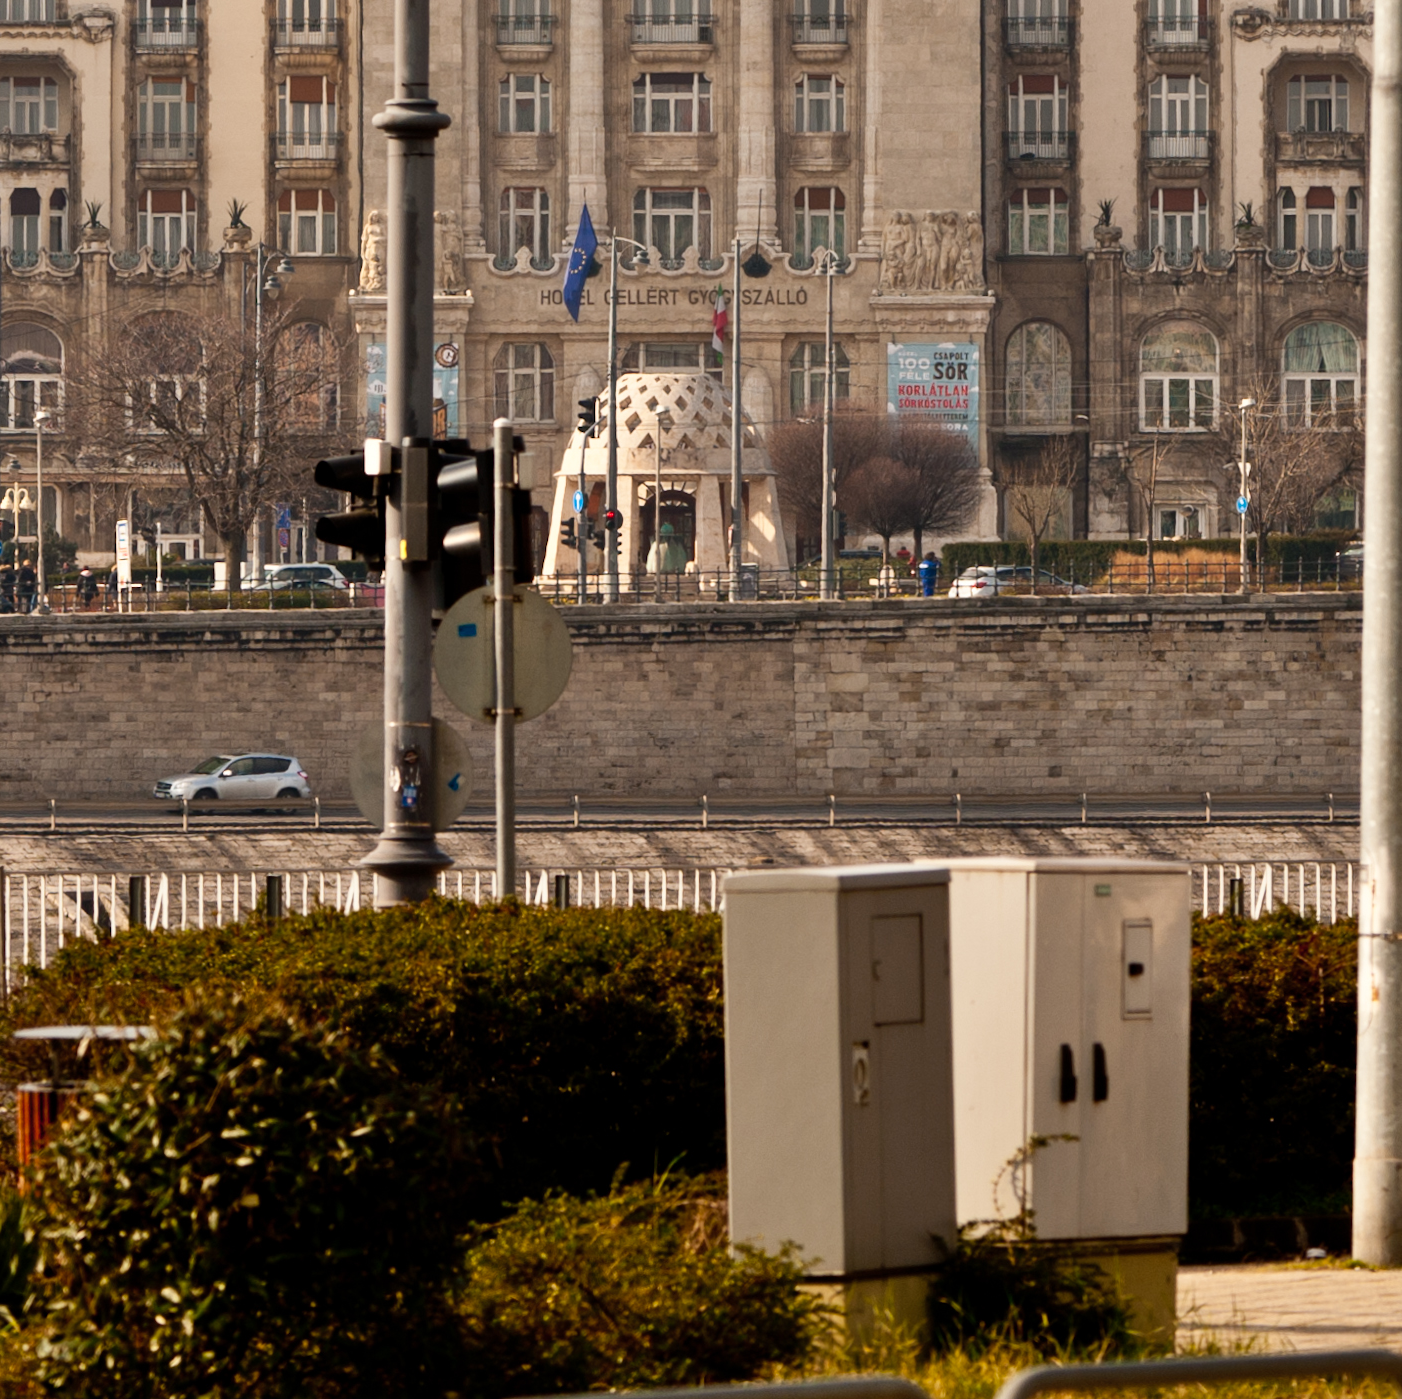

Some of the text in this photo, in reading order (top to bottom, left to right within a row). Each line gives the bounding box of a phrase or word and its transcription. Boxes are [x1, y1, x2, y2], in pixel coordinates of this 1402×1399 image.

[540, 289, 595, 305] HOEL
[933, 352, 969, 360] CSAPOLT
[899, 358, 930, 370] 100
[899, 369, 931, 380] FÉLE
[933, 361, 968, 380] SÖR
[898, 382, 969, 397] KORLÁTLAN
[899, 397, 969, 409] SÖRKÓSTOLÁS
